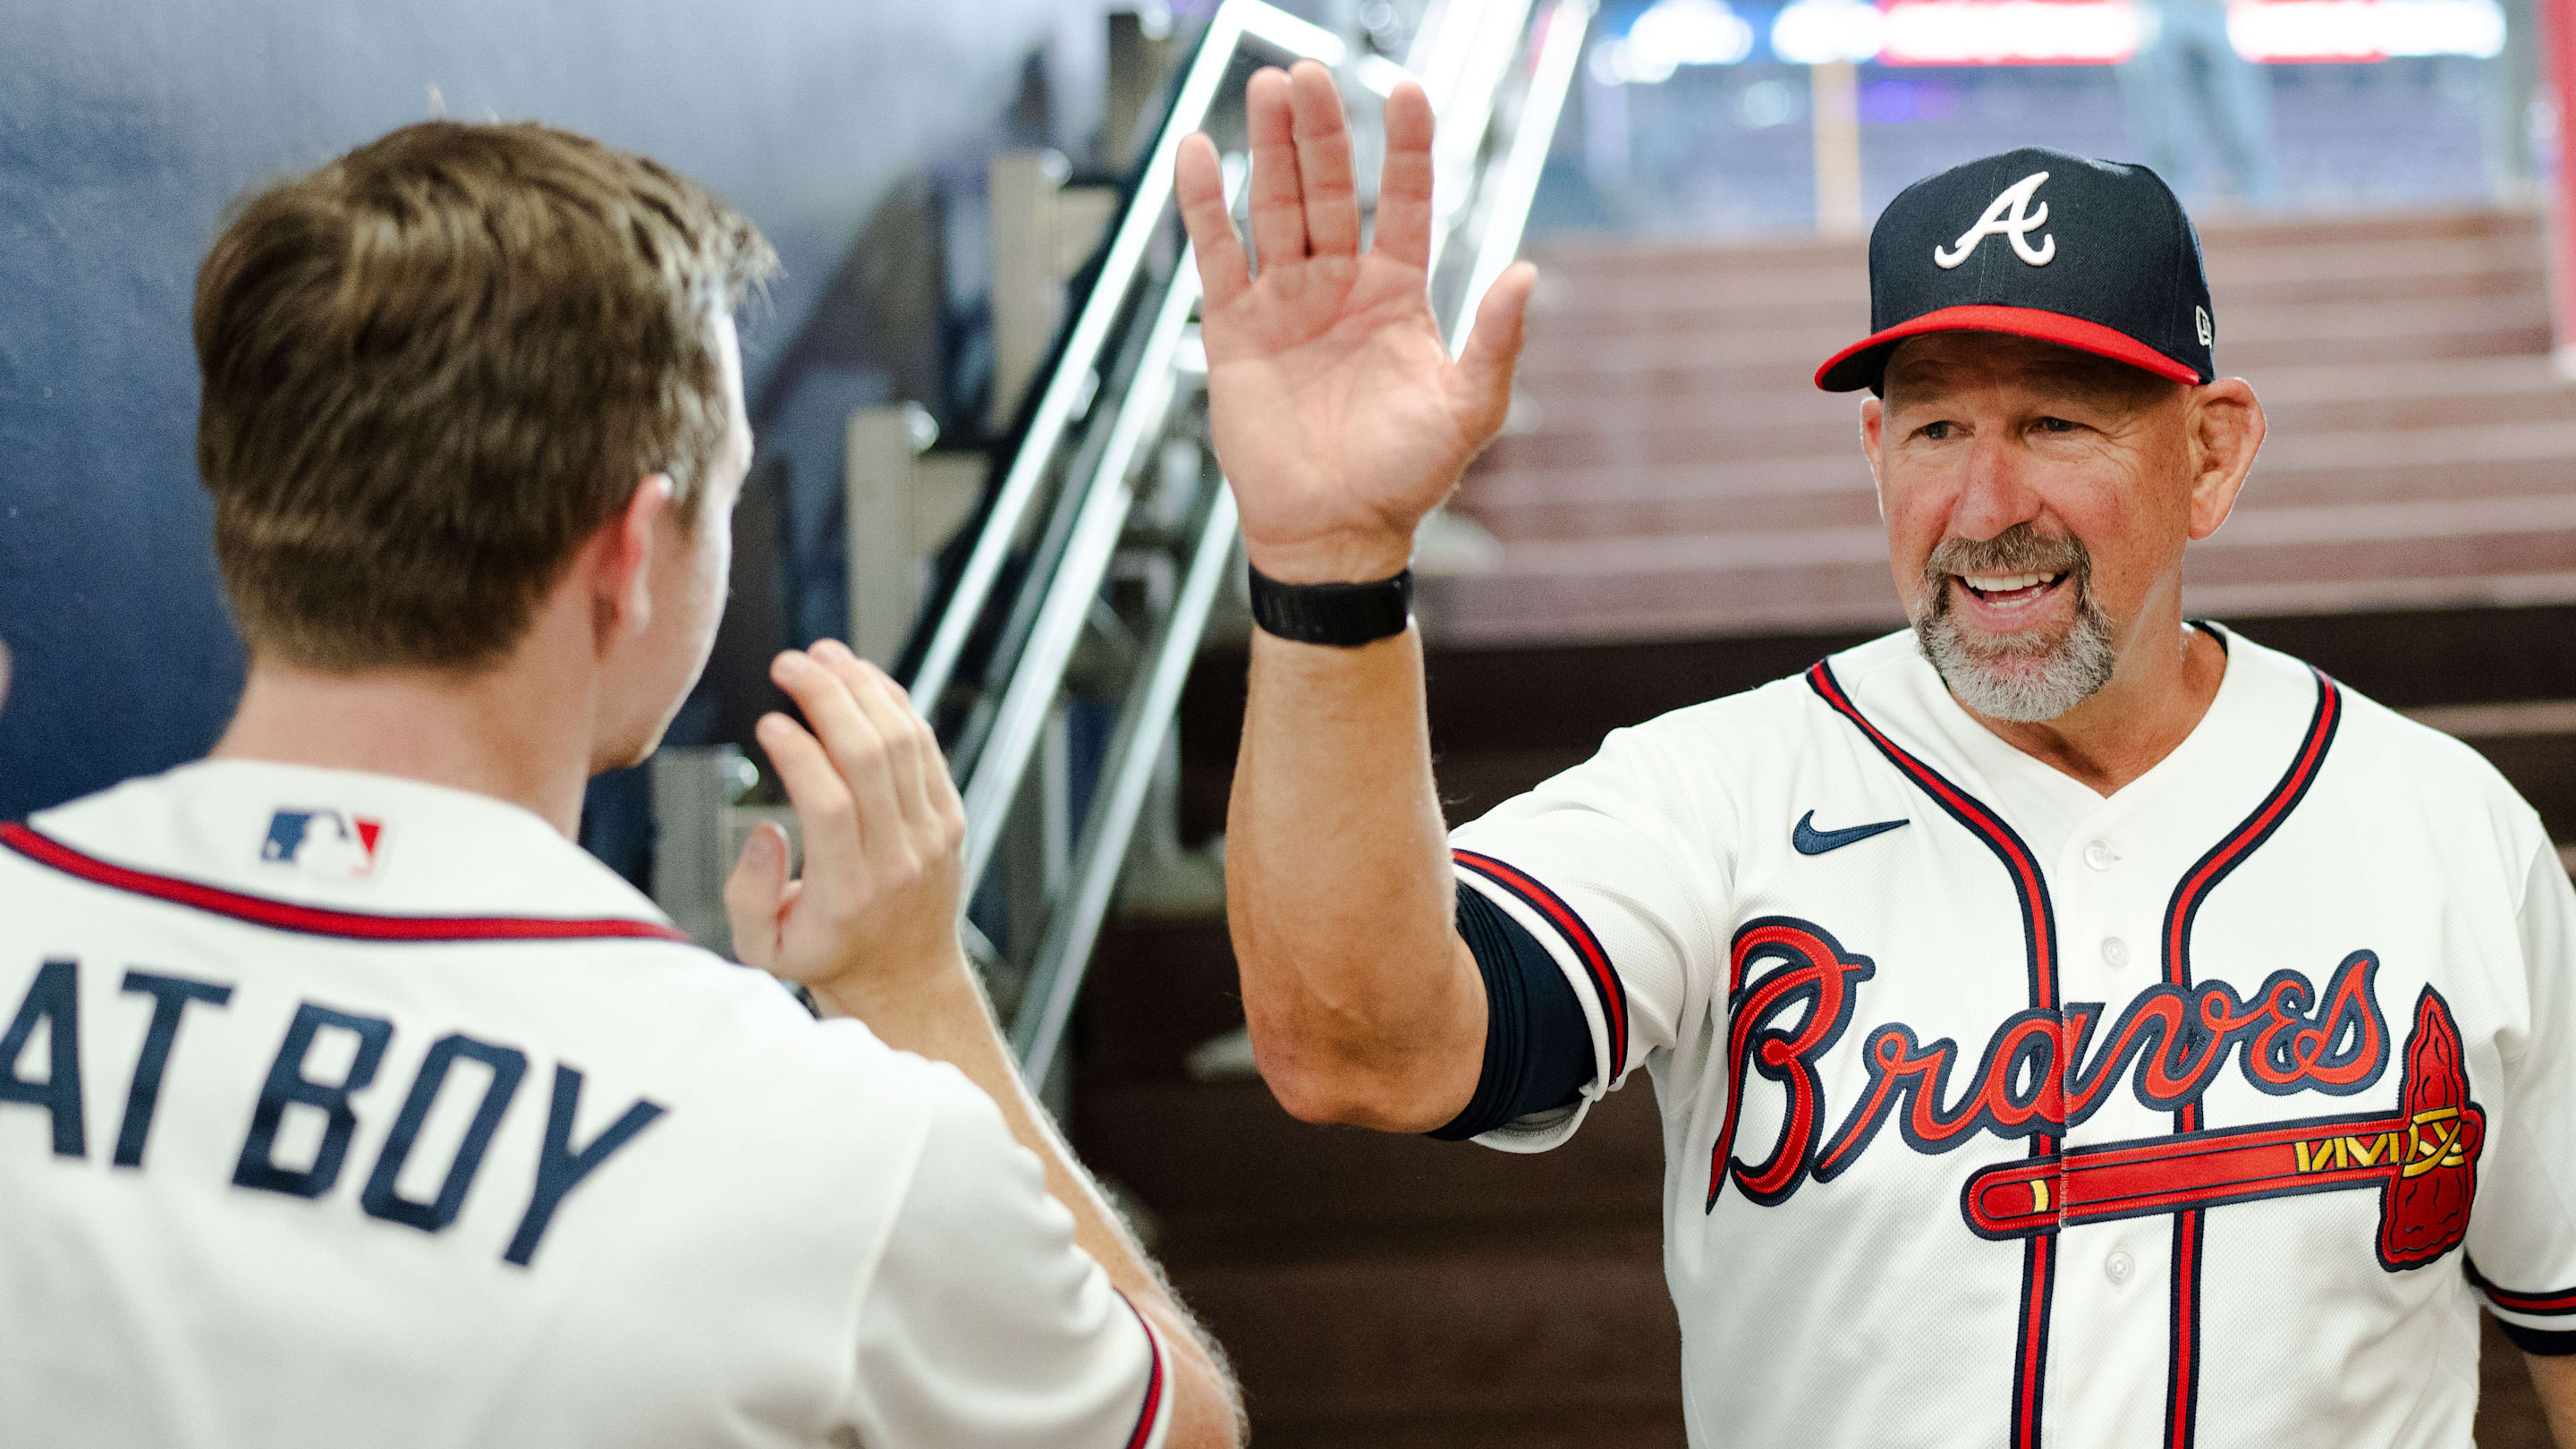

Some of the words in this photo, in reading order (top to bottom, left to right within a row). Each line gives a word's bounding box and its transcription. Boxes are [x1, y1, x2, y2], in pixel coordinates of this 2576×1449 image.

[1934, 171, 2056, 269] A
[231, 1001, 670, 1268] BOY
[1706, 915, 2392, 1215] Braves
